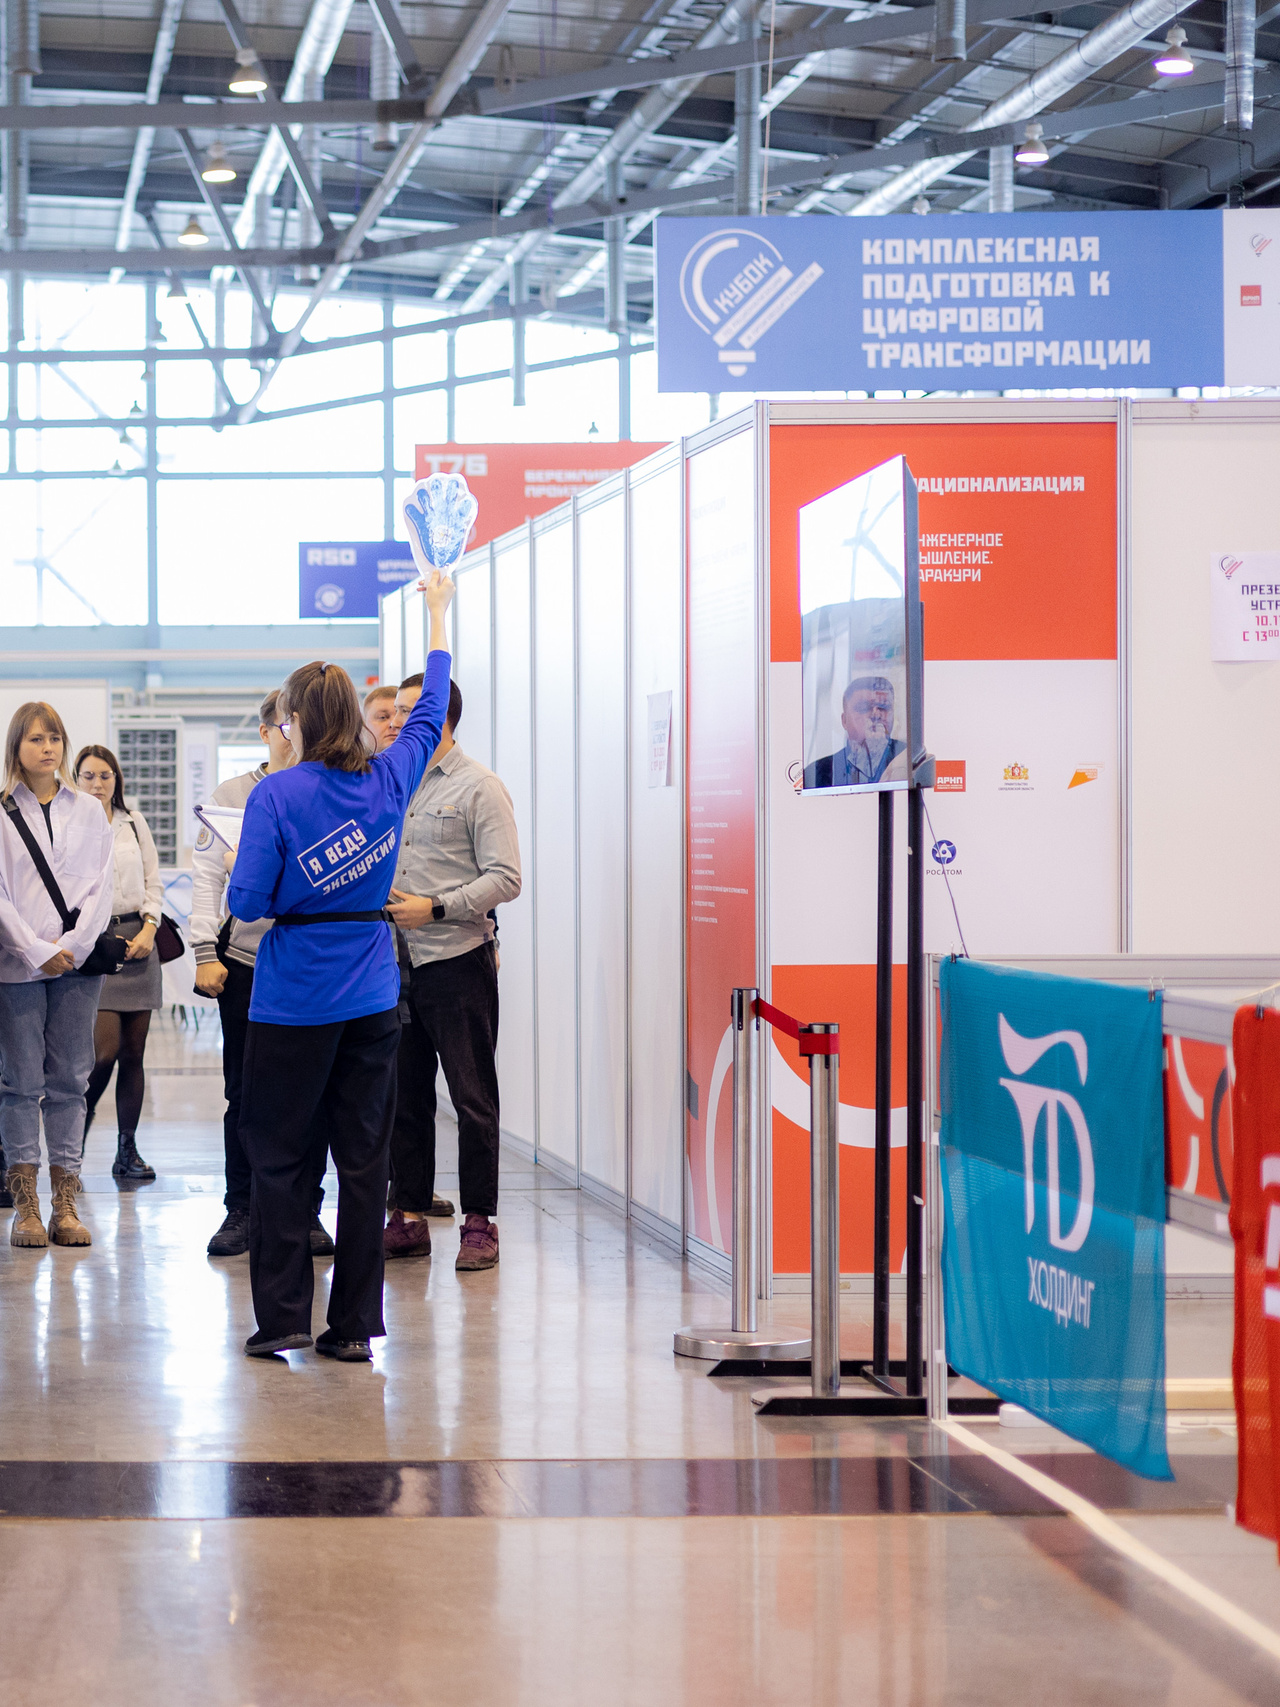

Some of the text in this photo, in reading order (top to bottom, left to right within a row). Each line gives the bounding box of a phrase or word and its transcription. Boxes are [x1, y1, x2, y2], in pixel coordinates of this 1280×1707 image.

[862, 236, 1100, 266] КОМПЛЕКСНАЯ
[713, 252, 774, 314] КУБОК
[862, 271, 1110, 304] ПОДГОТОВКА К
[862, 300, 1044, 339] ЦИФРОВОЙ
[861, 339, 1151, 370] ТРАНСФОРМАЦИИ
[914, 476, 1085, 496] АЦИОНАЛИЗАЦИЯ
[918, 533, 1003, 547] НЖЕНЕРНОЕ
[919, 551, 994, 565] ЫШЛЕНИЕ.
[919, 569, 982, 582] АРАКУРИ
[937, 776, 963, 784] АРНП
[308, 828, 368, 875] Я ВЕДУ
[322, 831, 396, 896] ЭКСКУРСИЮ
[1027, 1256, 1095, 1330] ХОЛДИНГ
